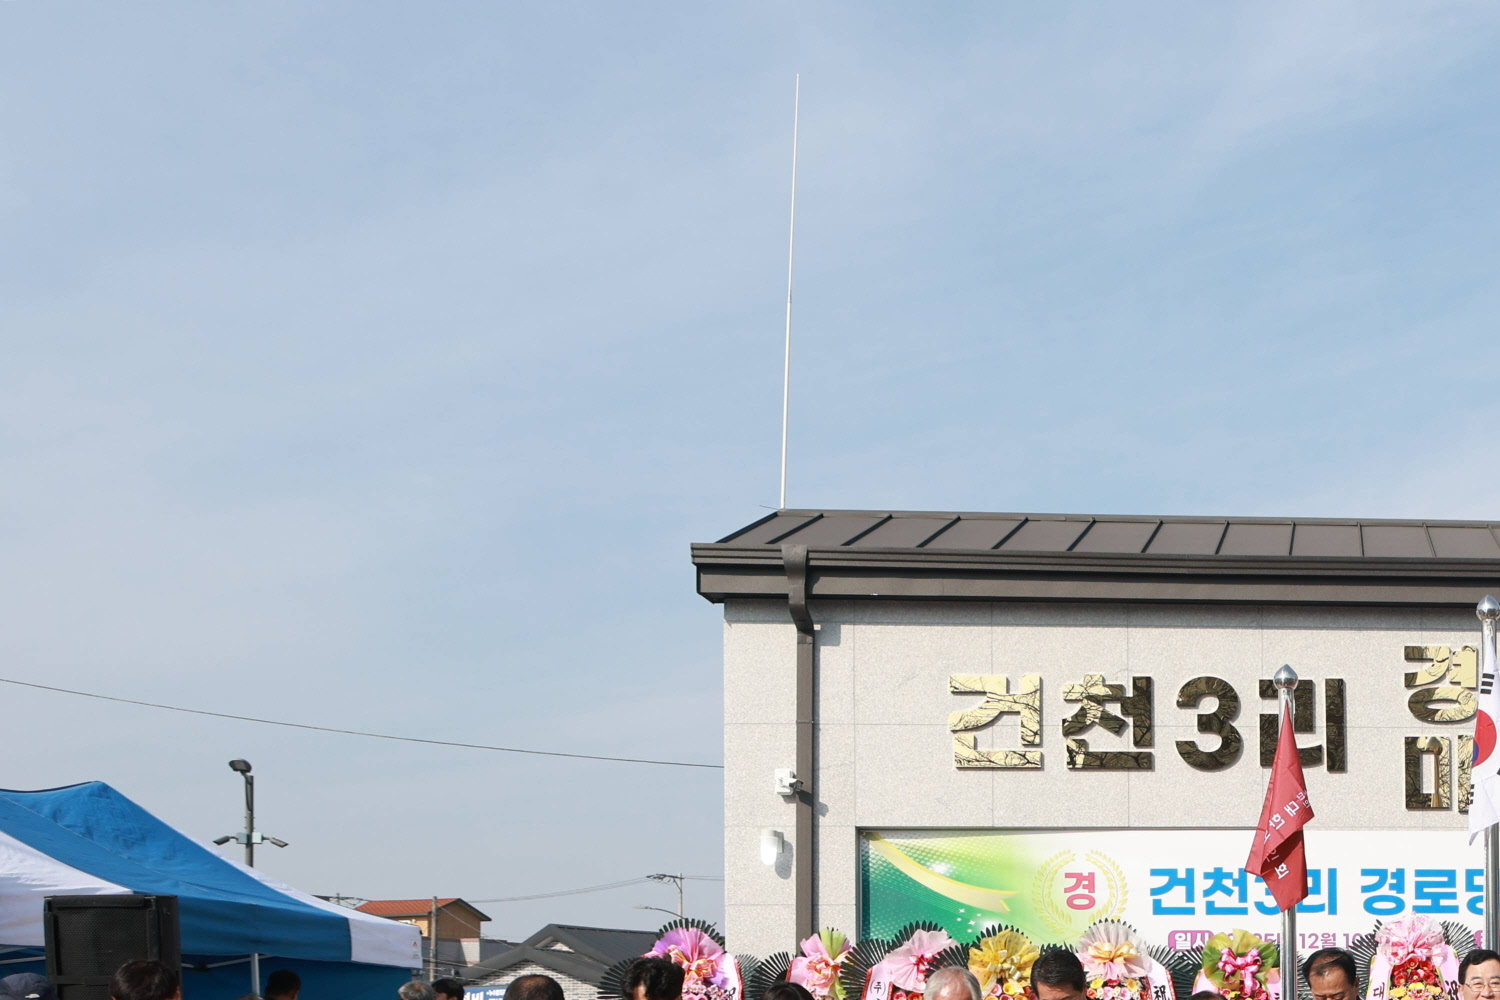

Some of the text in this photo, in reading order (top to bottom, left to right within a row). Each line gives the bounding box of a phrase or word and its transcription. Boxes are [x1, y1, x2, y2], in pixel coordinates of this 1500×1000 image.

[949, 673, 1347, 773] 건천3리
[1063, 871, 1096, 910] 경
[1300, 932, 1337, 949] 12월
